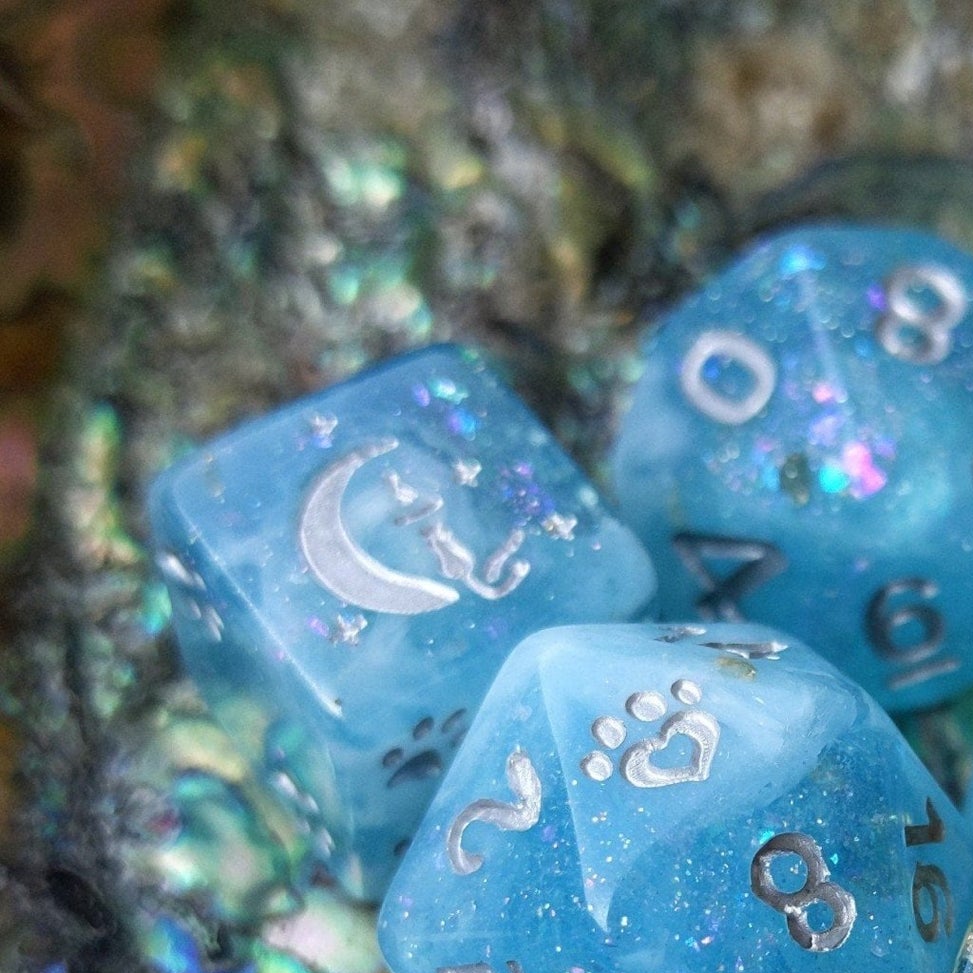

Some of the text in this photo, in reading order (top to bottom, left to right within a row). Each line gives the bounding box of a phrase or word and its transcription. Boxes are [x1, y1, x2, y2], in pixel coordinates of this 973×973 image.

[875, 261, 967, 366] 8
[680, 329, 778, 426] 0
[865, 577, 960, 689] 6
[447, 748, 541, 875] 2
[905, 797, 954, 942] 16
[750, 832, 857, 952] 8
